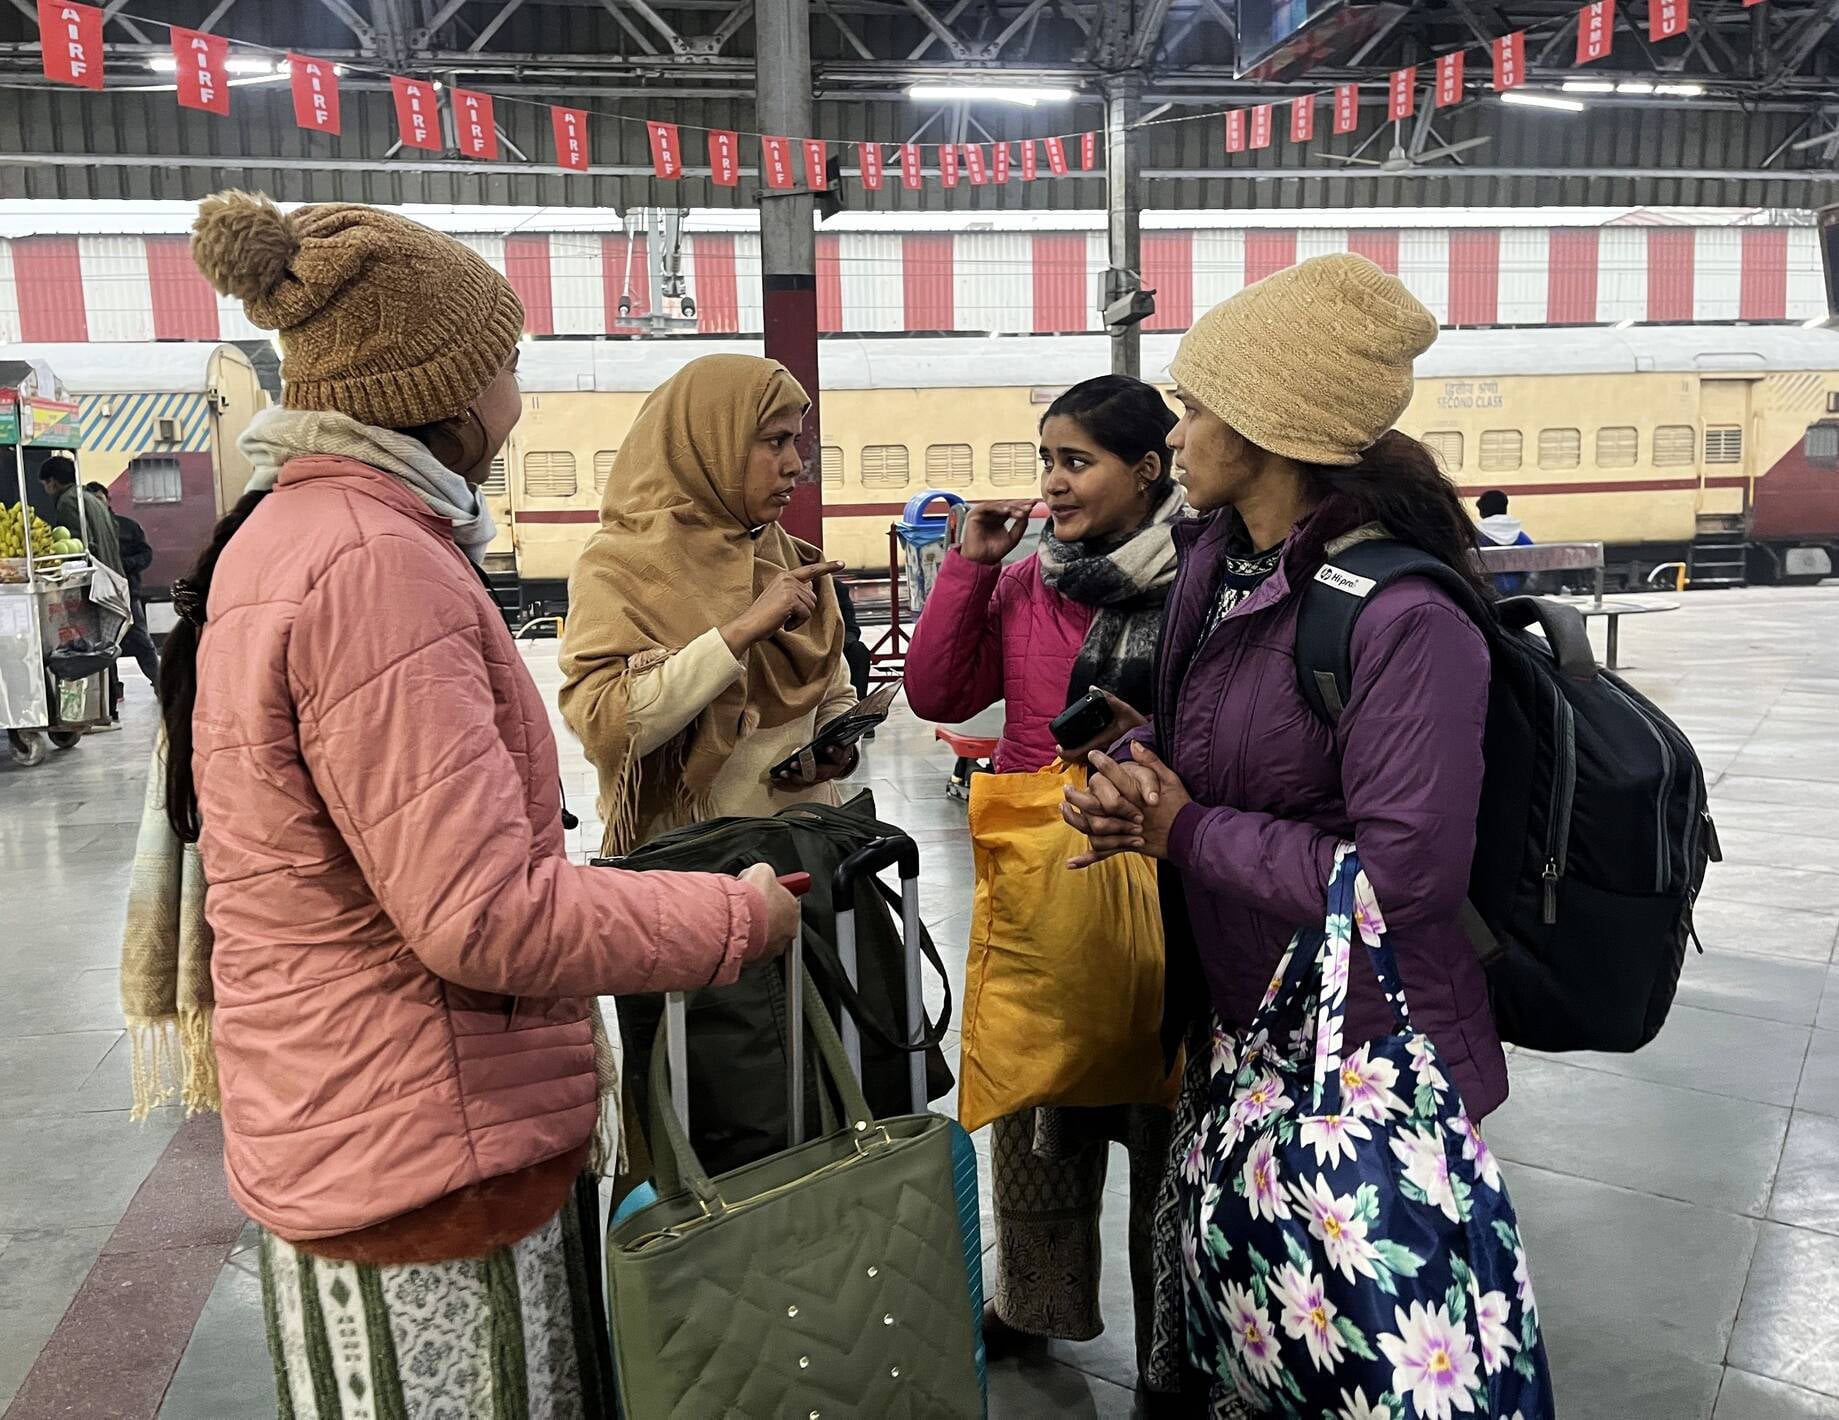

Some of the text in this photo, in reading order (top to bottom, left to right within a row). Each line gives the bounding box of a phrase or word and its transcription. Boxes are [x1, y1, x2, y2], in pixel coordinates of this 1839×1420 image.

[61, 8, 87, 77] AIRF
[191, 38, 214, 103] AIRF
[306, 62, 329, 124] AIRF
[407, 86, 427, 142] AIRF
[466, 96, 484, 152] AIRF
[564, 113, 580, 164] AIRF
[657, 127, 674, 174] AIRF
[719, 135, 732, 181] AIRF
[770, 141, 785, 184] AIRF
[810, 144, 823, 185] AIRF
[1437, 395, 1504, 409] SECOND CLASS
